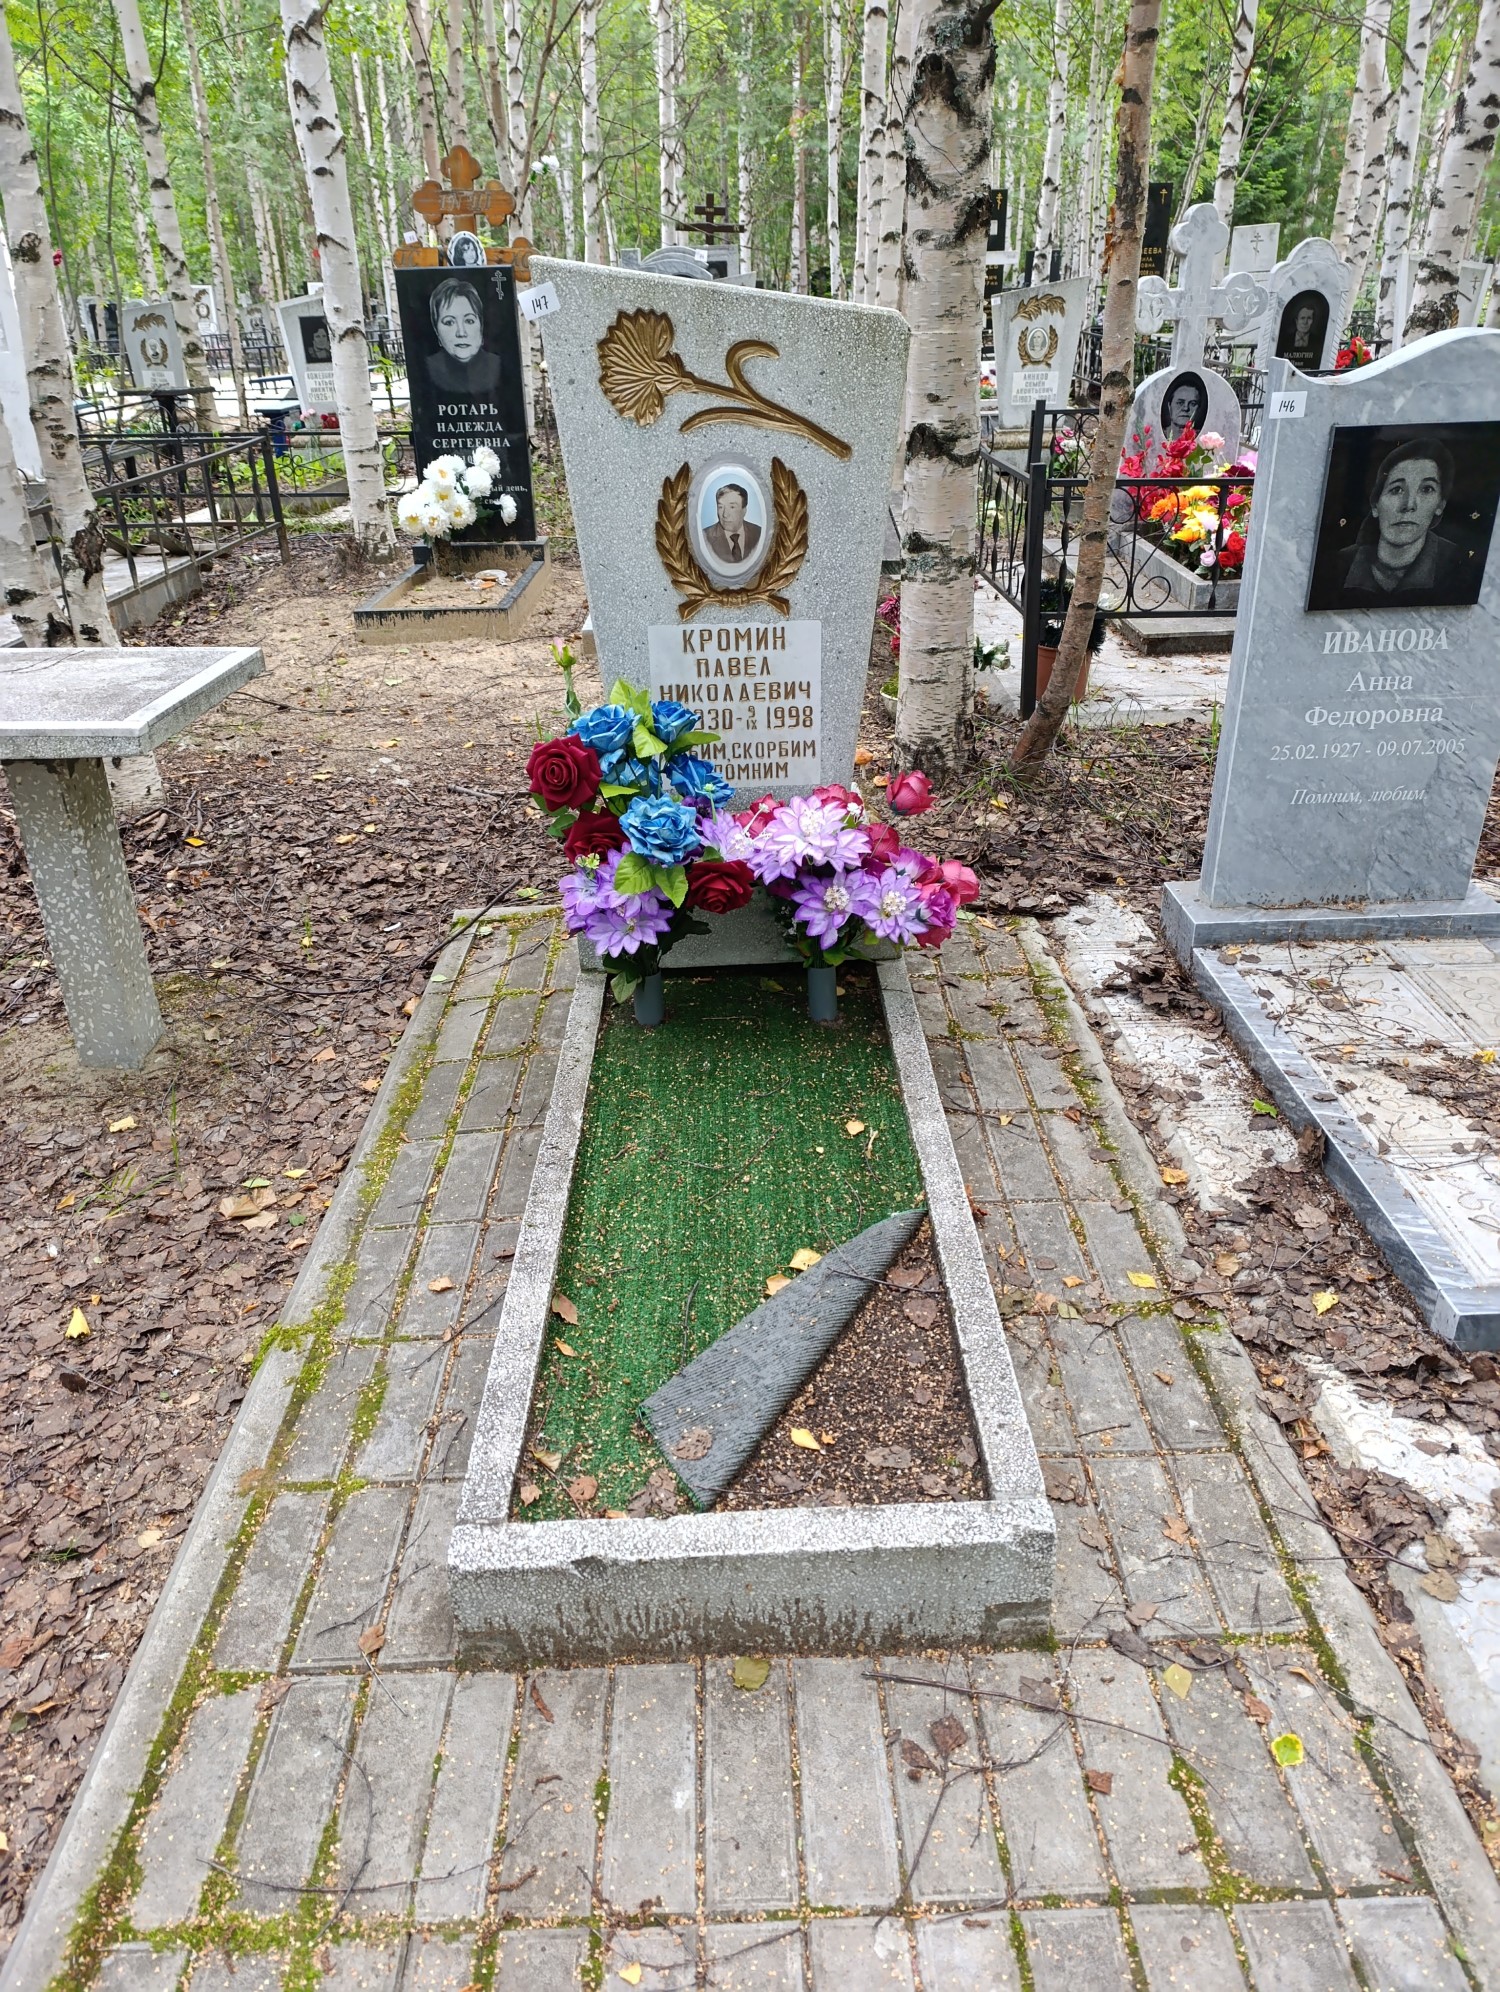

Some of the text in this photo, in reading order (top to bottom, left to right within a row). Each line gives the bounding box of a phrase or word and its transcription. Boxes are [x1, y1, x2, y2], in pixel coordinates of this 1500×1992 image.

[1143, 247, 1163, 255] ЕЕВА
[531, 295, 549, 314] 147
[438, 403, 499, 416] РОТАРЬ
[1278, 399, 1296, 413] 146
[436, 421, 503, 433] НАДЕЖДА
[432, 438, 511, 449] СЕРГЕЕВНА
[682, 626, 786, 654] КРОМИН
[1322, 627, 1450, 655] ИВАНОВА
[696, 656, 771, 678] ПАВЕЛ
[659, 680, 811, 704] НИКОЛАЕВИЧ
[1346, 671, 1414, 692] Анна
[766, 705, 814, 730] 1998
[1304, 706, 1444, 730] Федоровна
[1270, 742, 1362, 762] 25.02.1927
[1376, 738, 1467, 757] 09.07.2005
[1290, 789, 1363, 805] Помним,
